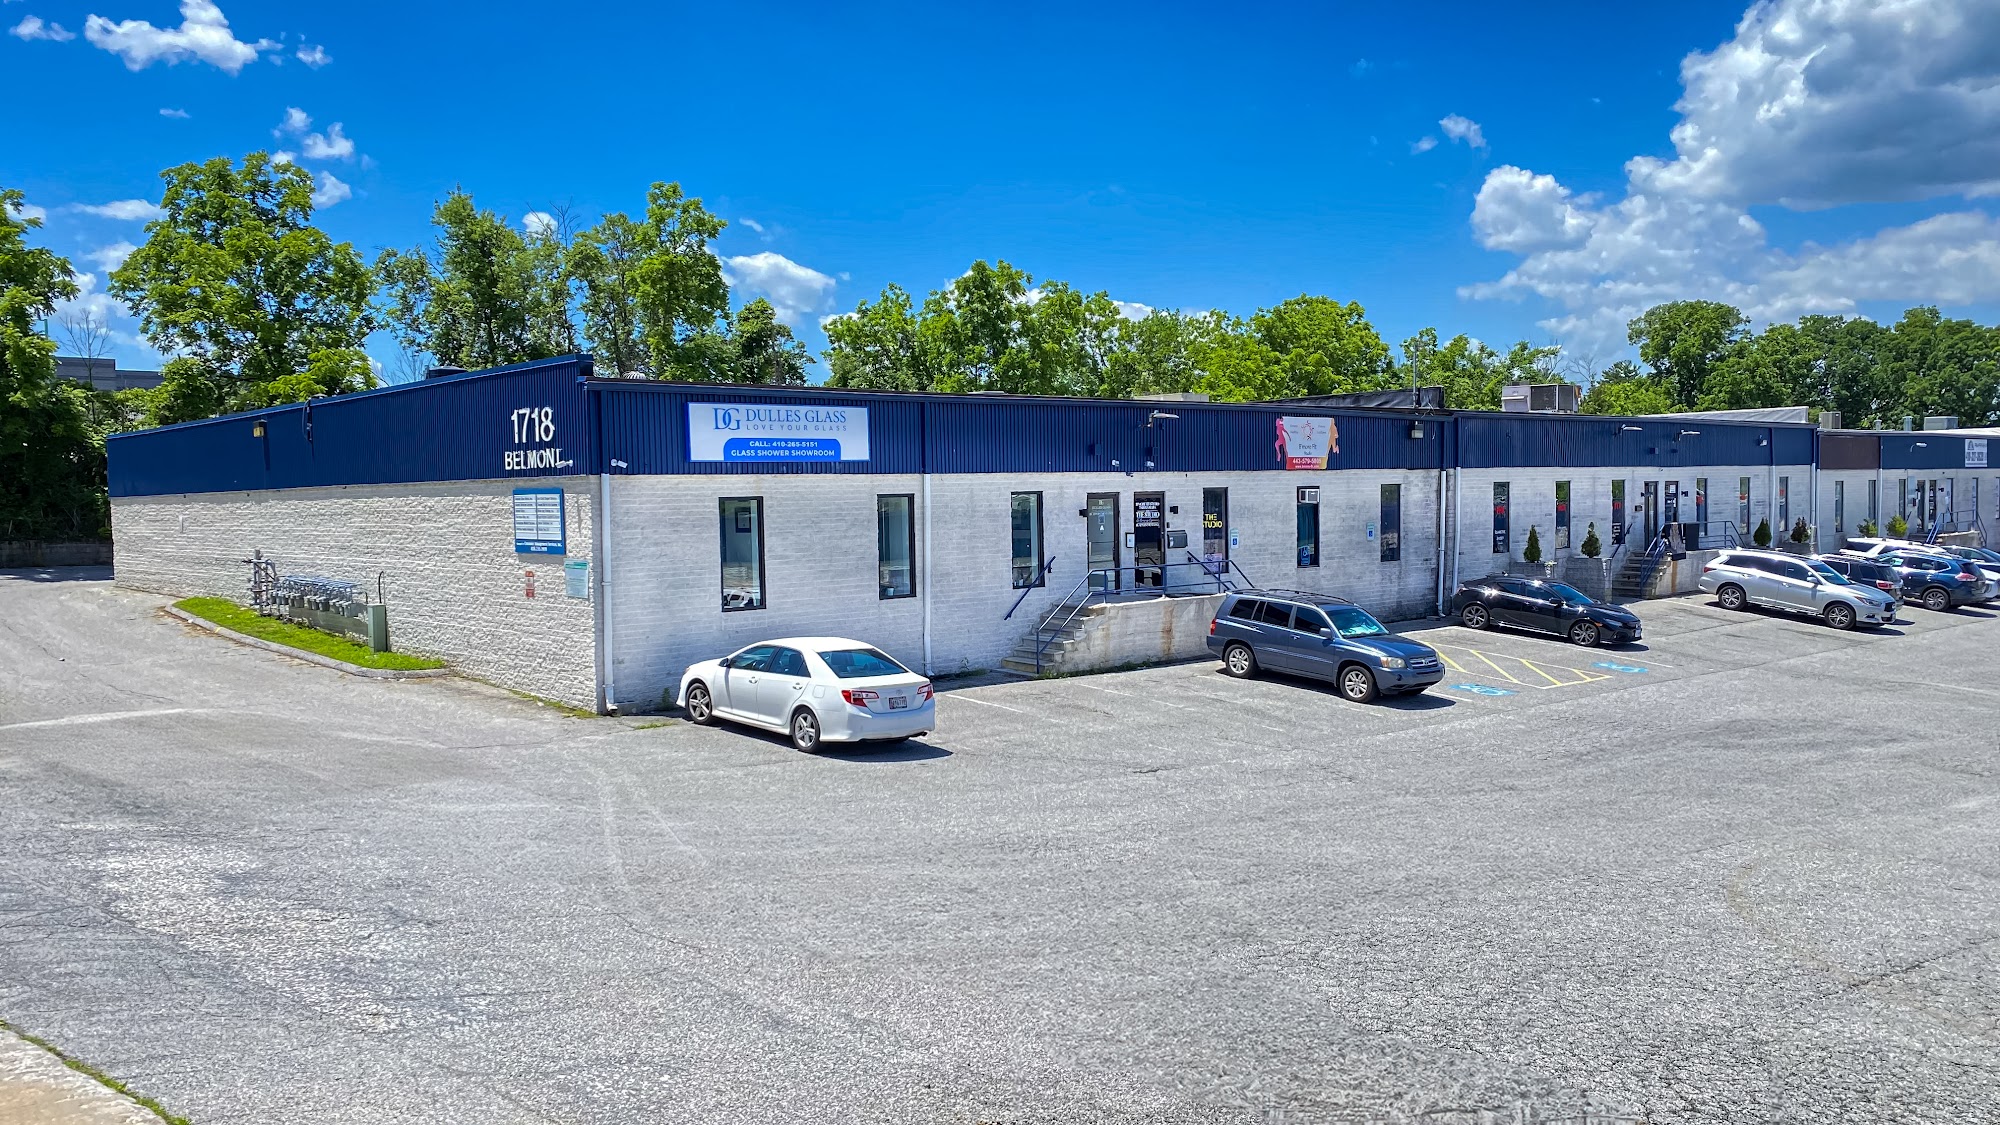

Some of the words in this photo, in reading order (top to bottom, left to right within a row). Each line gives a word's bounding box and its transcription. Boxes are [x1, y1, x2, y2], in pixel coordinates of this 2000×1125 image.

[745, 408, 801, 422] DULLES
[804, 410, 847, 423] GLASS
[511, 407, 555, 443] 1718
[505, 448, 563, 470] BELMONT
[731, 449, 756, 457] GLASS
